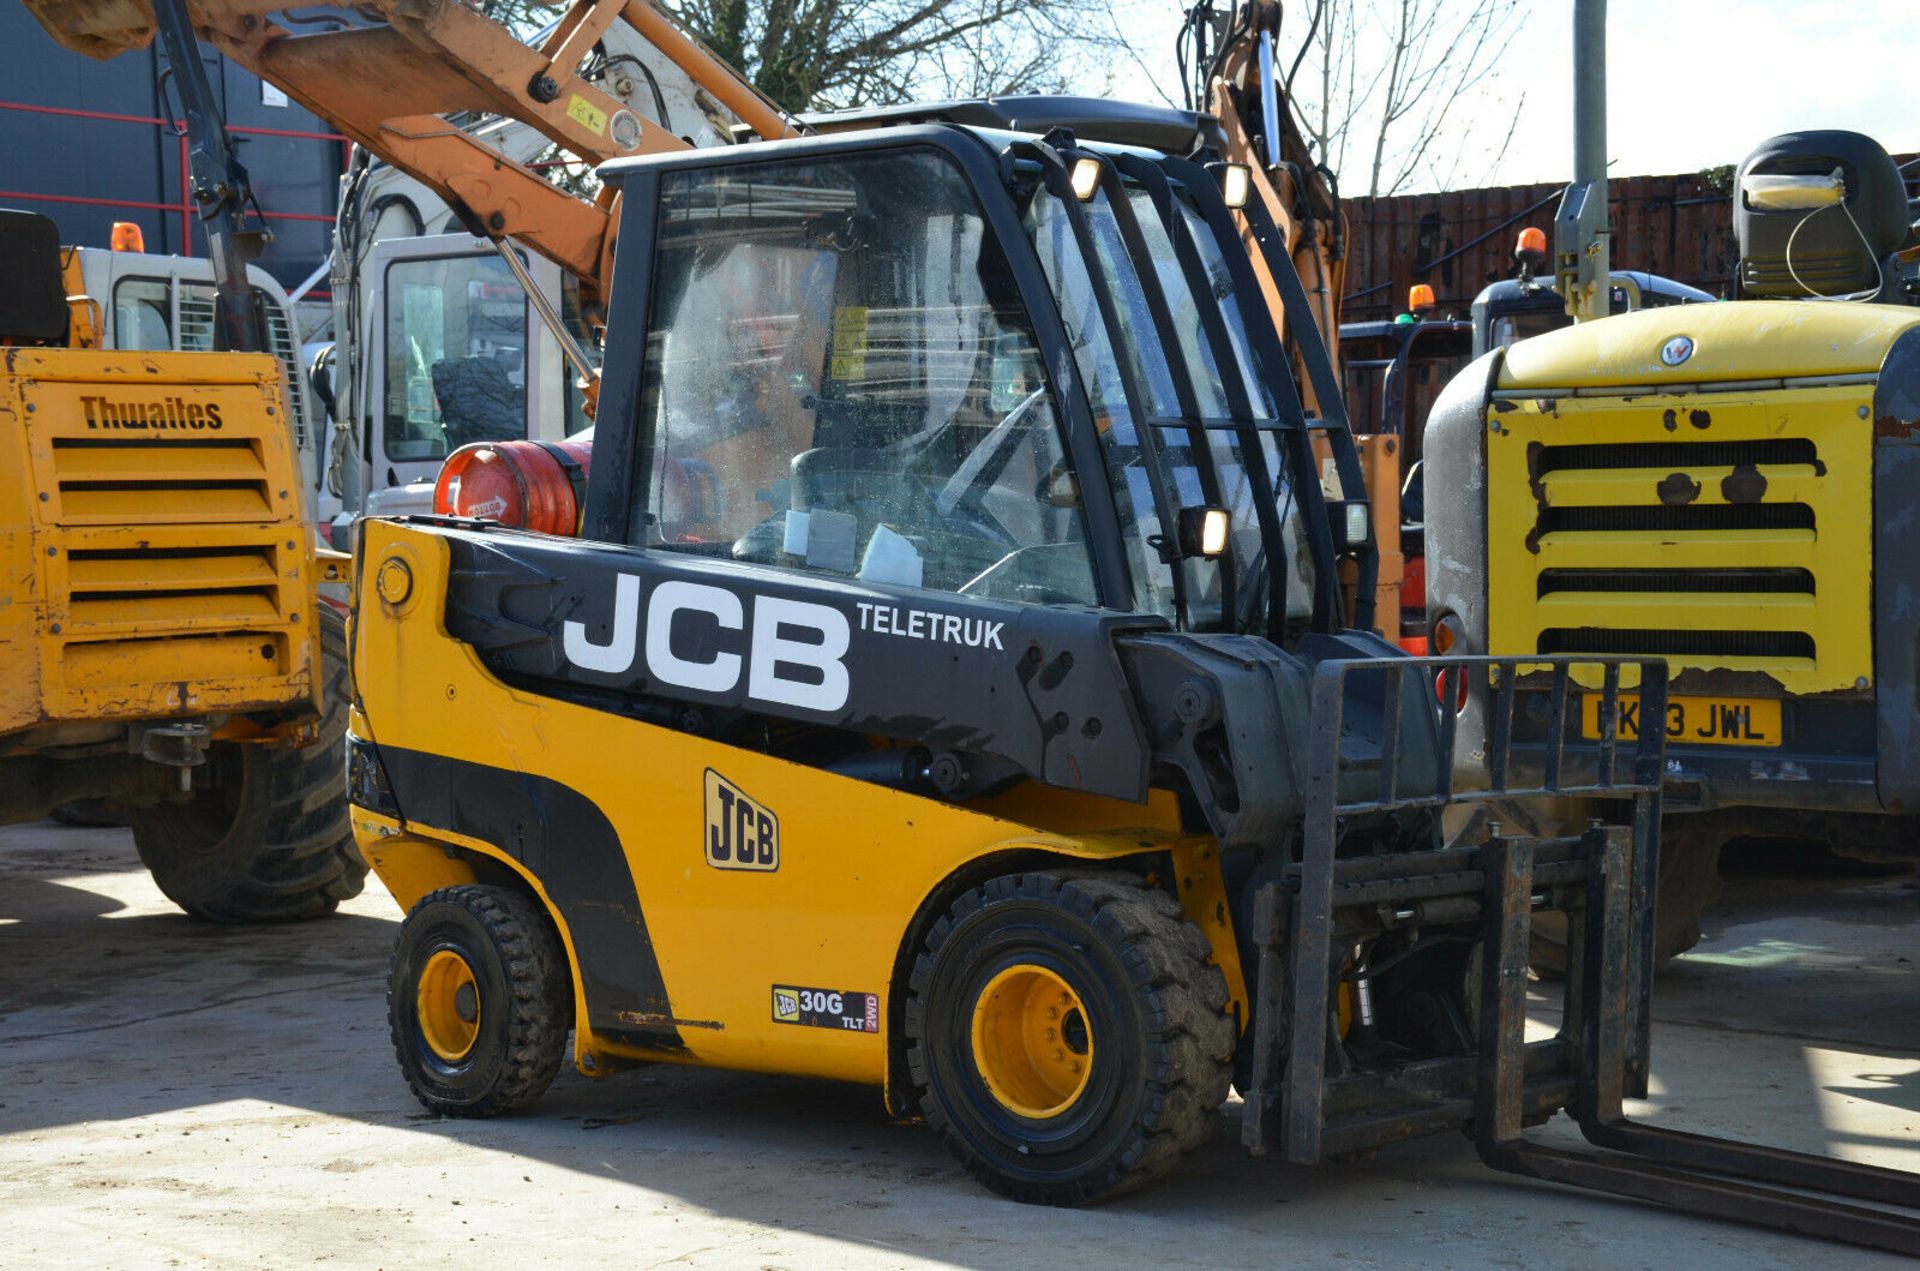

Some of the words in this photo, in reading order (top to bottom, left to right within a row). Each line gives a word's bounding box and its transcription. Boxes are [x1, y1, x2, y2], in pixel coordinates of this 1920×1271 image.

[80, 396, 222, 429] Thwaites
[563, 573, 850, 711] JCB
[857, 602, 1004, 651] TELETRUK
[1697, 704, 1764, 740] JWL
[711, 783, 774, 865] JCB
[778, 995, 797, 1015] JCB
[800, 990, 843, 1014] 30G
[866, 996, 877, 1029] 2WD
[842, 1016, 864, 1030] TLT
